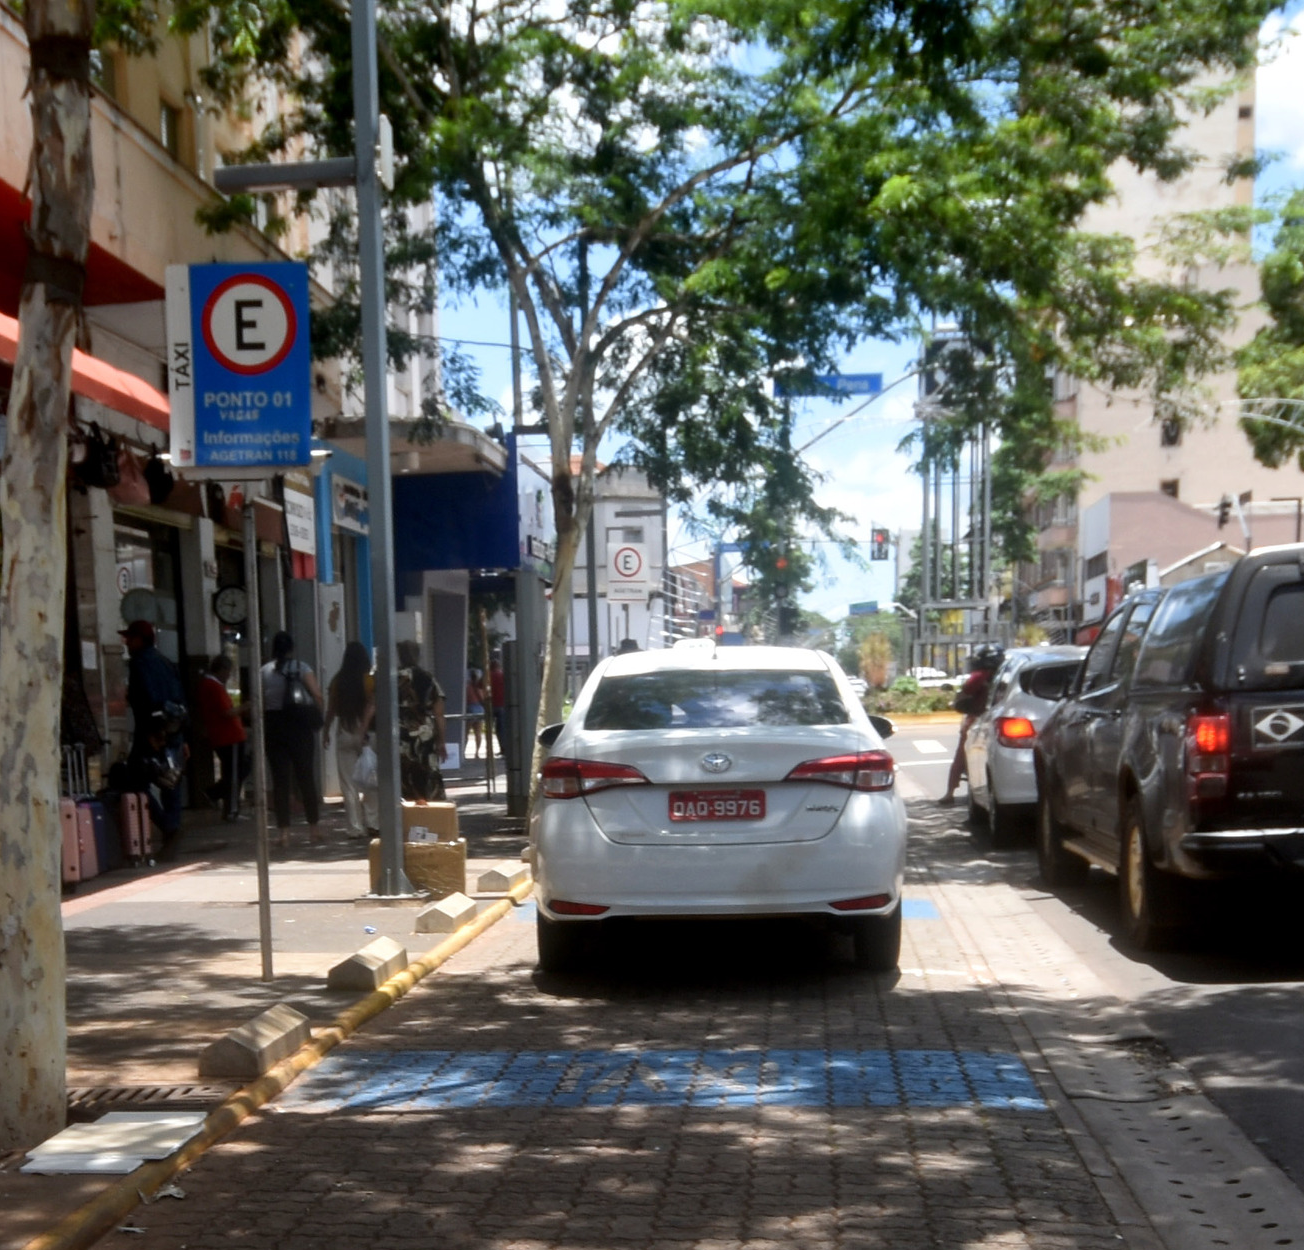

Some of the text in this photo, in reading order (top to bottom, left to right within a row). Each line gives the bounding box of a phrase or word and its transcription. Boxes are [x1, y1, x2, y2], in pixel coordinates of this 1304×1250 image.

[234, 299, 266, 351] E
[169, 342, 191, 391] TÁXI
[203, 391, 293, 409] PONTO 01
[203, 430, 300, 446] Informações
[209, 450, 273, 462] AGETRAN
[623, 555, 633, 570] E
